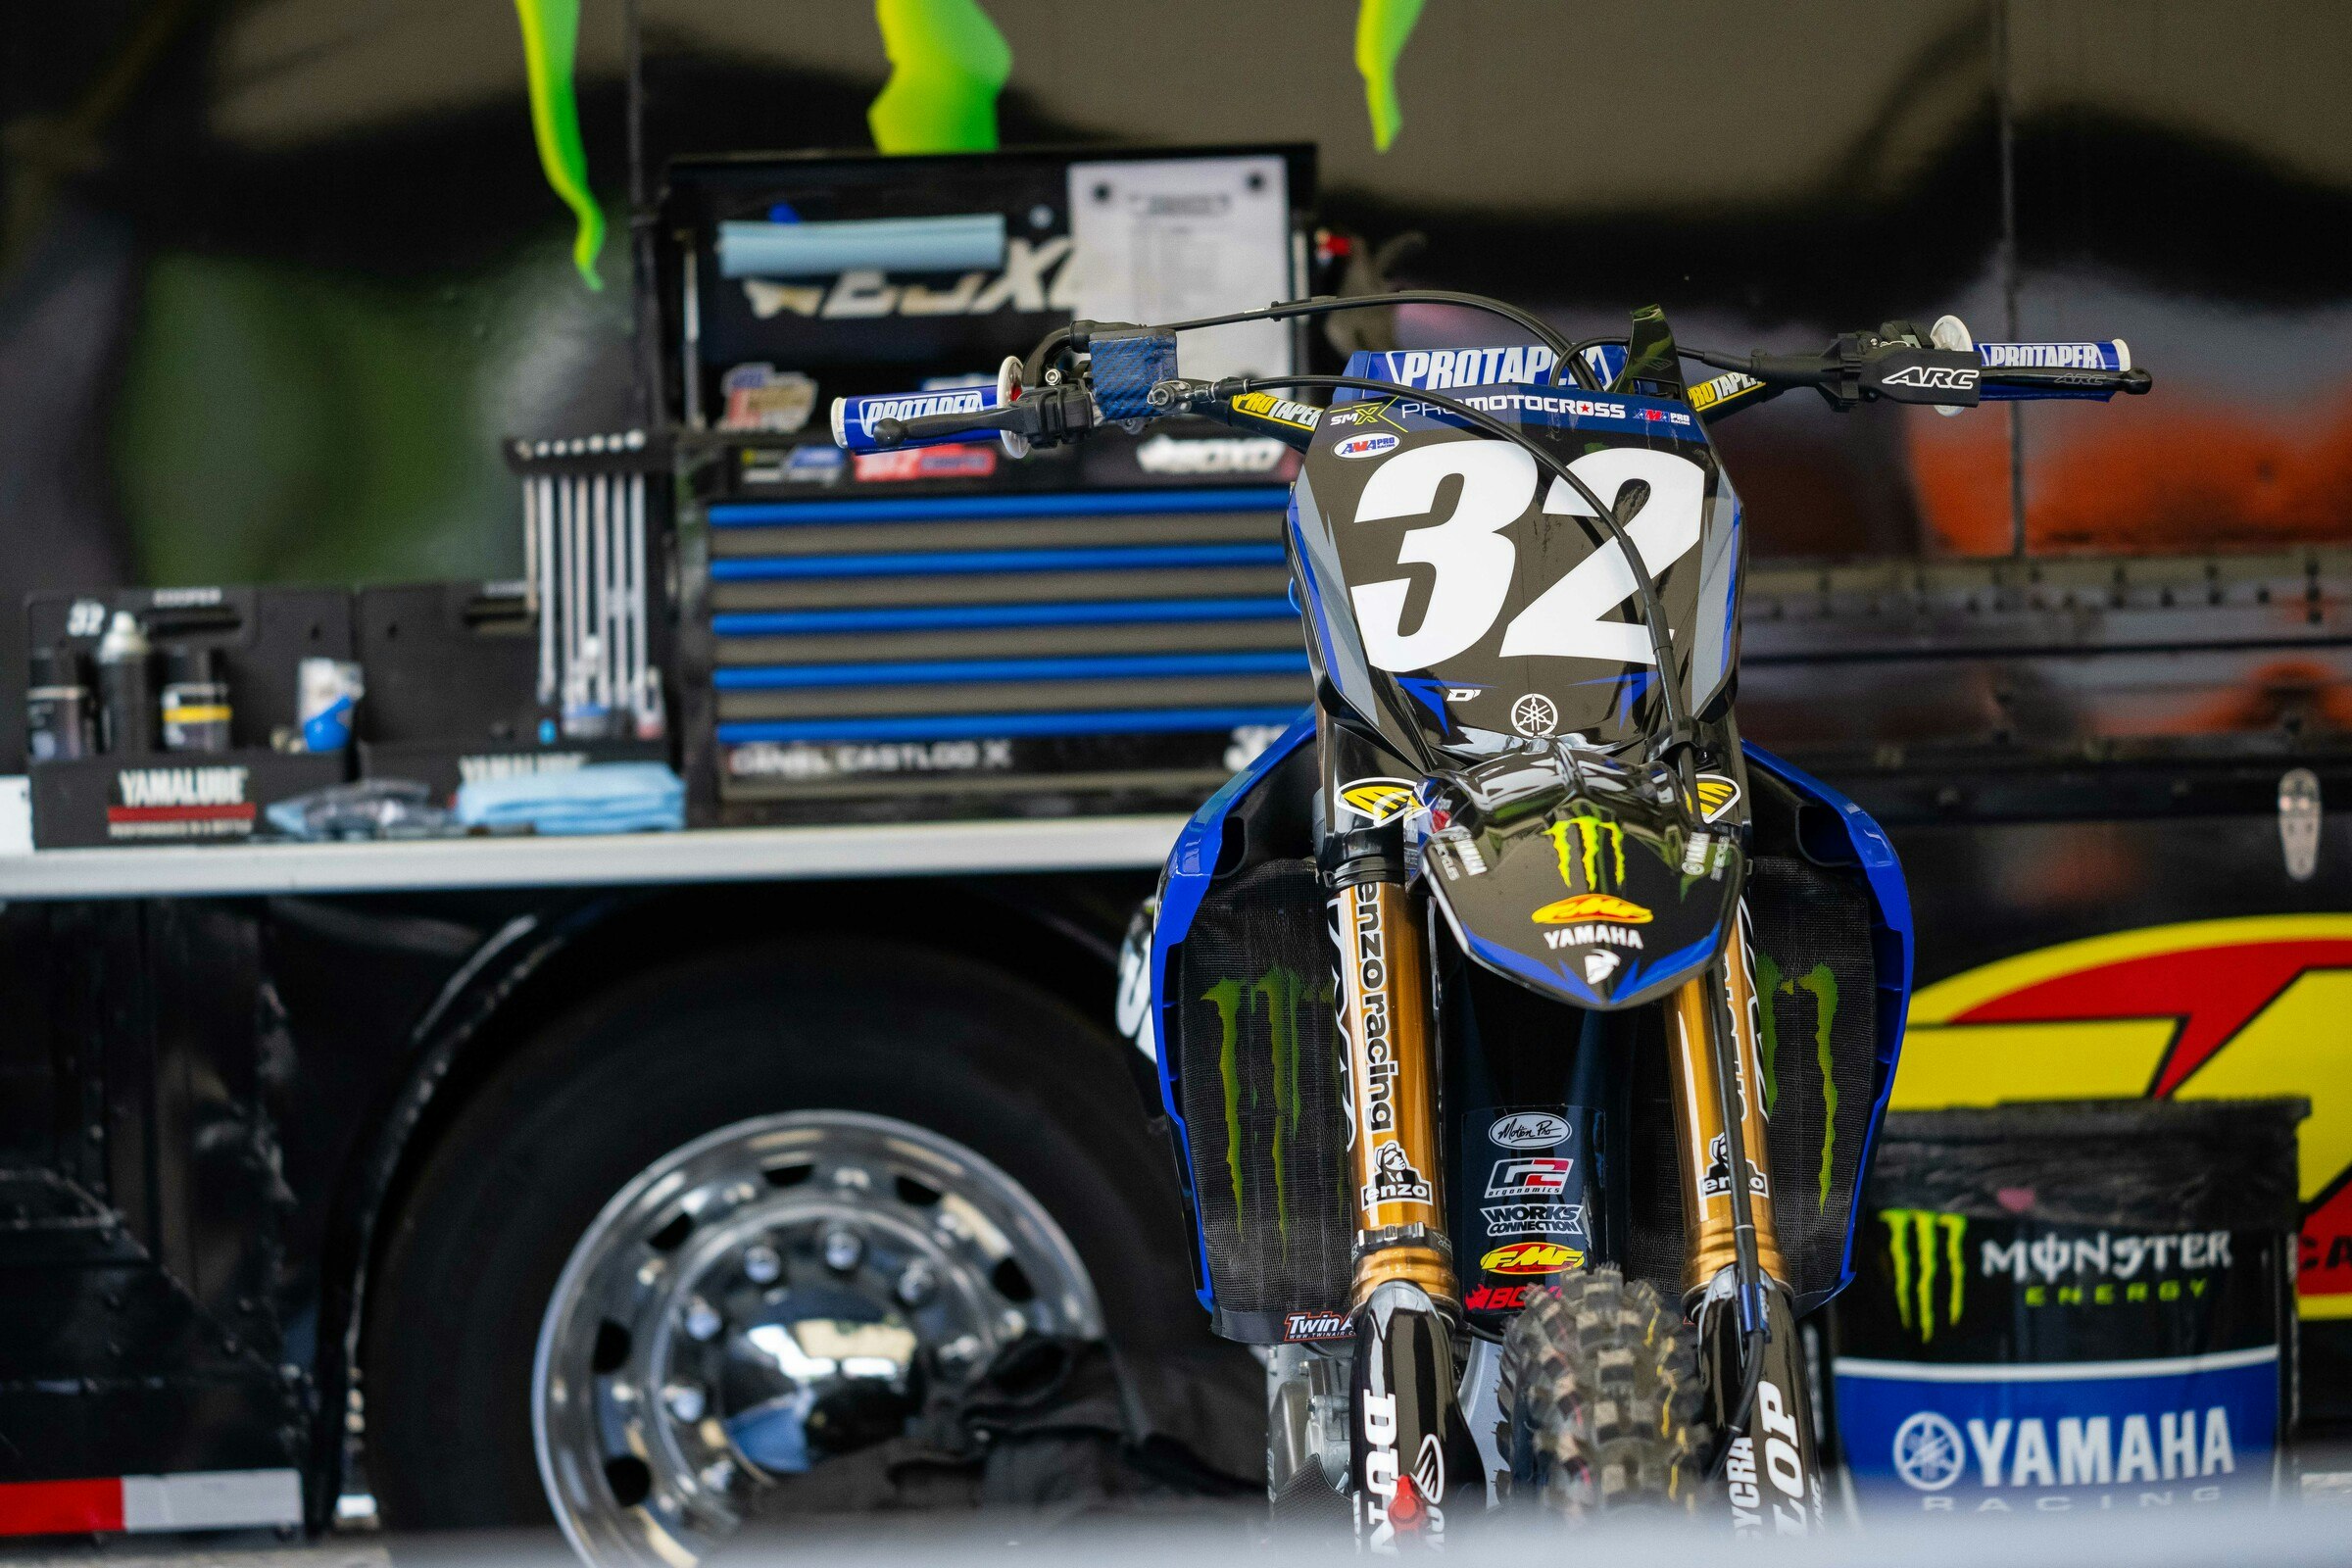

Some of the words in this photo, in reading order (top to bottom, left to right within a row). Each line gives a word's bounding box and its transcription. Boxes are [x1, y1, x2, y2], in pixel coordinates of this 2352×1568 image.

[1882, 366, 1980, 390] ARC
[1330, 406, 1380, 426] SMX
[1670, 413, 1690, 422] PRO
[1341, 440, 1377, 455] AMA
[1350, 439, 1705, 672] 32
[1544, 924, 1644, 950] YAMAHA
[1365, 1182, 1429, 1200] enzo
[1703, 1175, 1765, 1194] eno
[1484, 1205, 1582, 1223] WORKS
[1488, 1220, 1580, 1234] CONNECTION
[1481, 1246, 1585, 1270] FMF
[2025, 1278, 2209, 1307] ENERGY
[1289, 1315, 1339, 1335] Twin
[1967, 1406, 2234, 1488] YAMAHA
[1923, 1486, 2222, 1513] RACING
